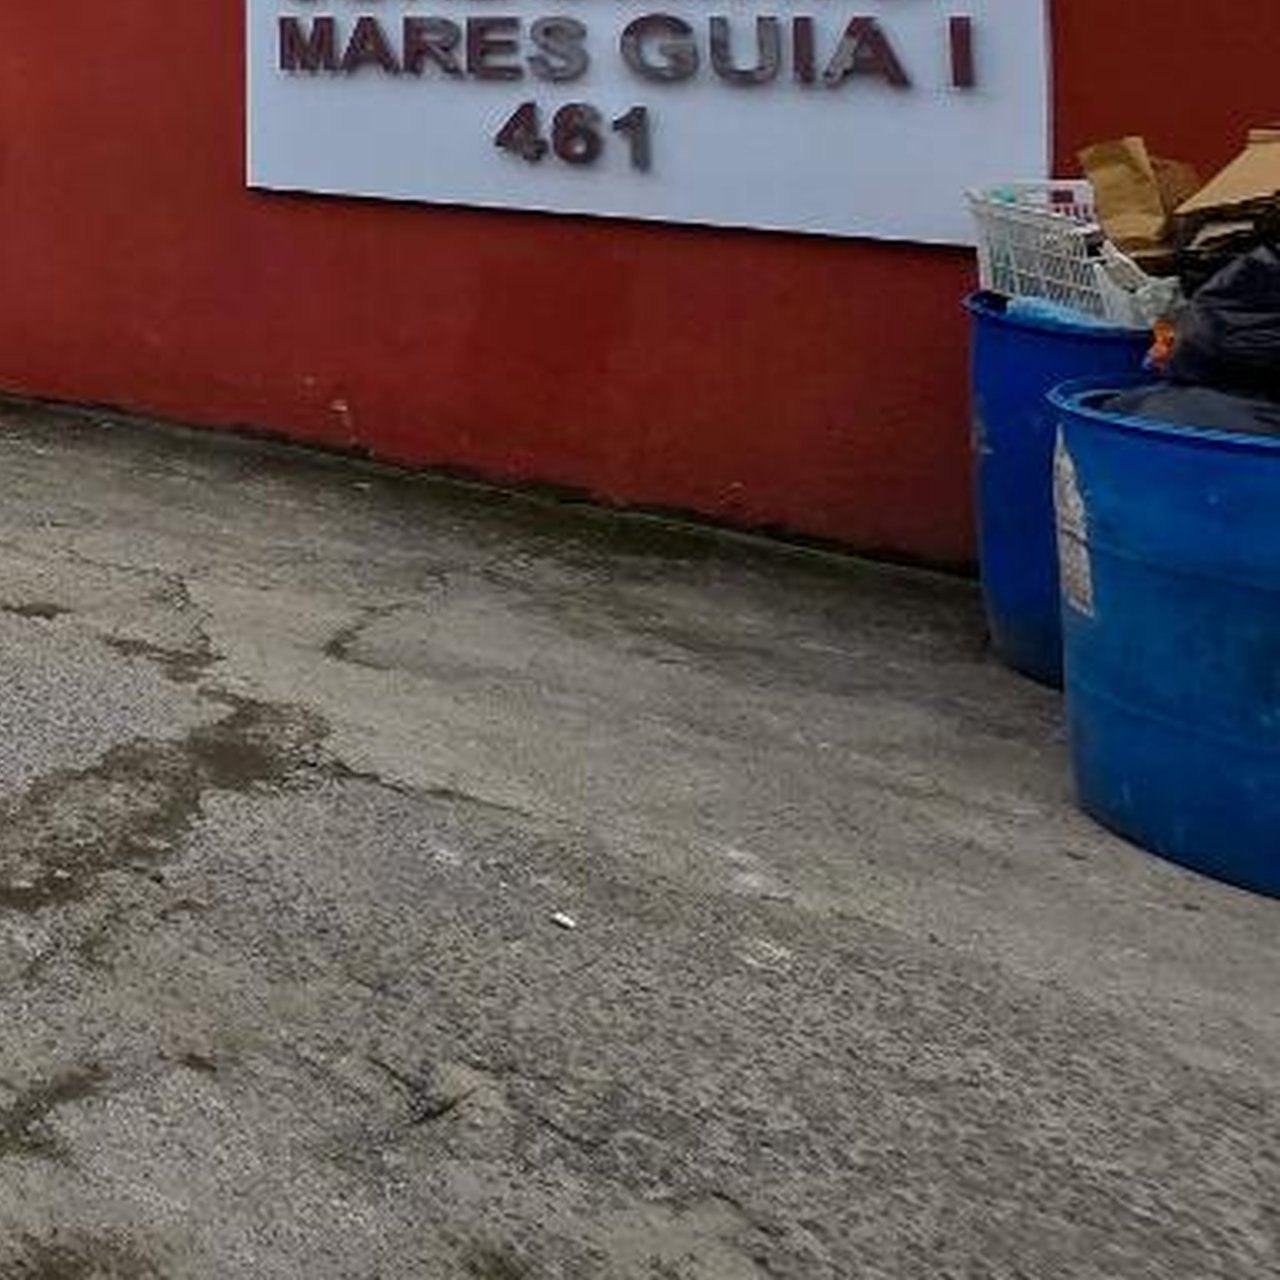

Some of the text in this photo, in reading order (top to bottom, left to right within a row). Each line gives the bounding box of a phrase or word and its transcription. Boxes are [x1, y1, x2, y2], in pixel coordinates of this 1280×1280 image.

[278, 13, 975, 89] MARES GUIA I
[494, 101, 652, 173] 461
